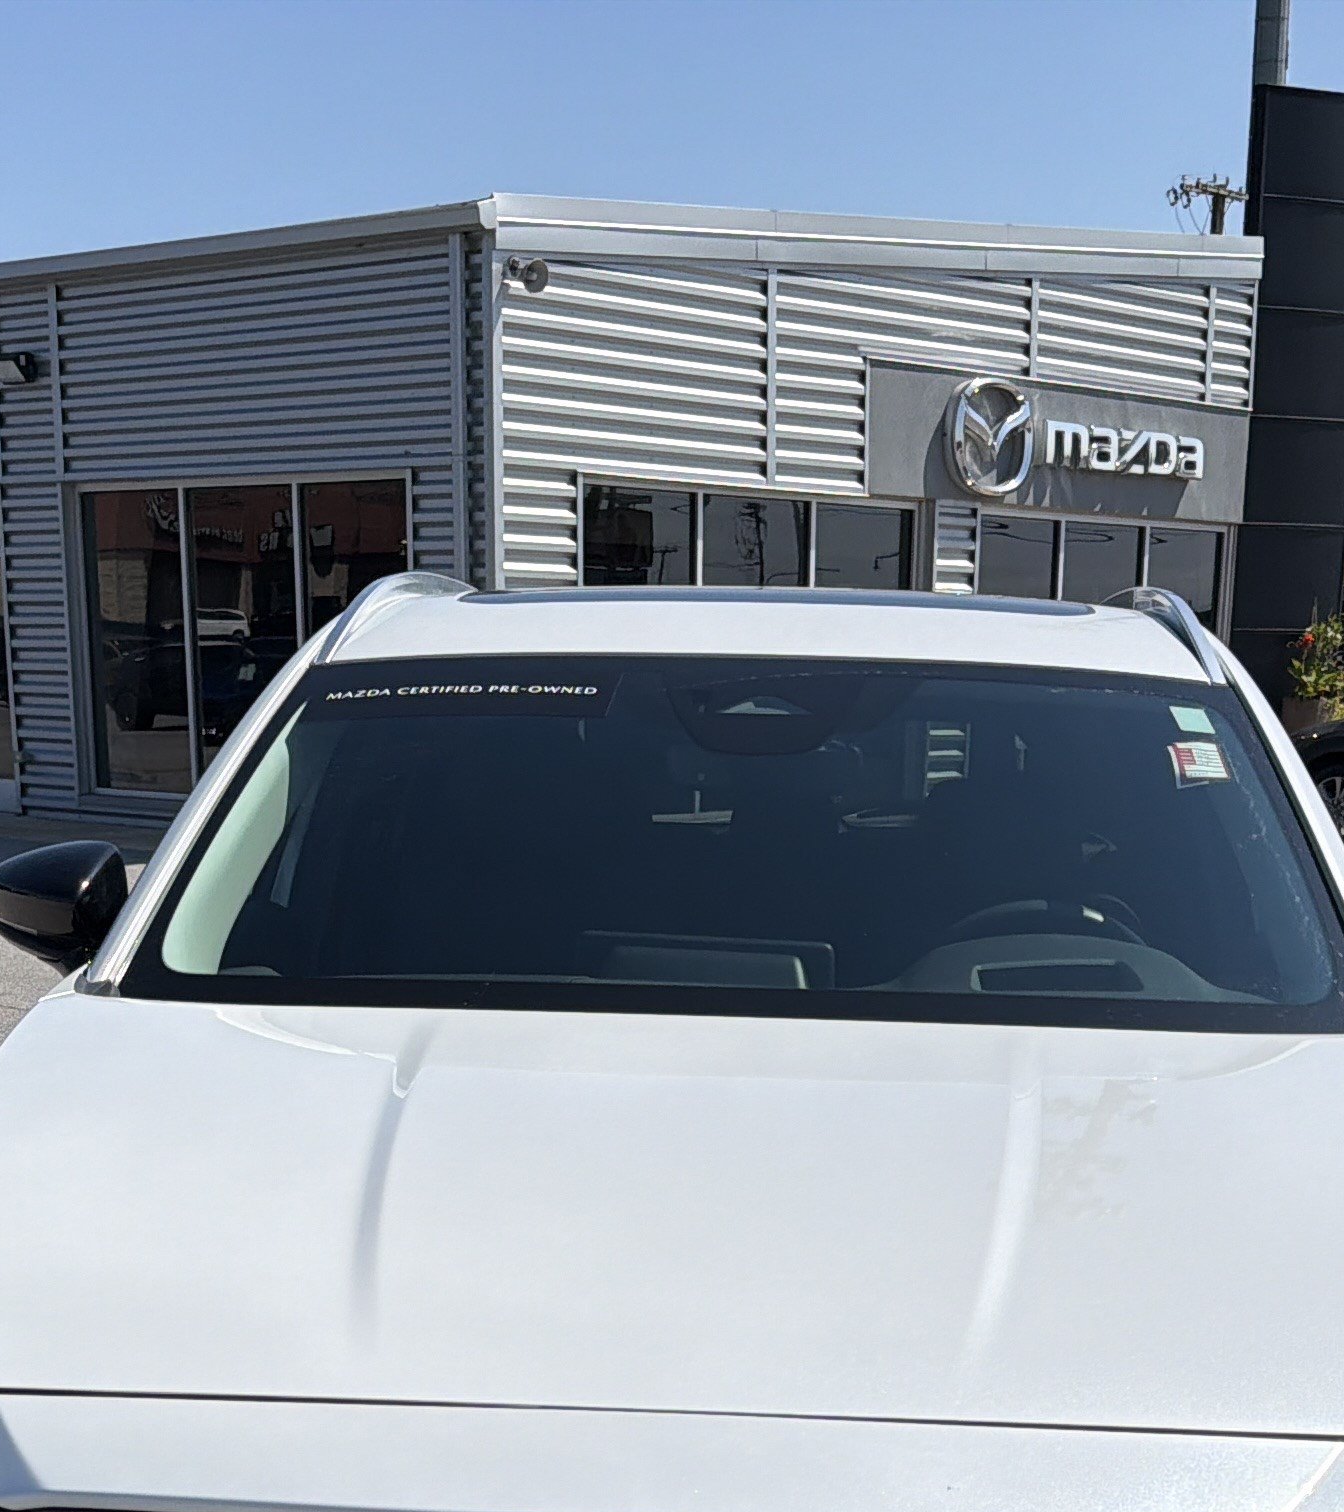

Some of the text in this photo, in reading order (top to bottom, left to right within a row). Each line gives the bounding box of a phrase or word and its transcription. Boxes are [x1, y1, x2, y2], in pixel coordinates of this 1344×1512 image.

[325, 685, 598, 700] MAZDA CERTIFIED PRE-OWNED
